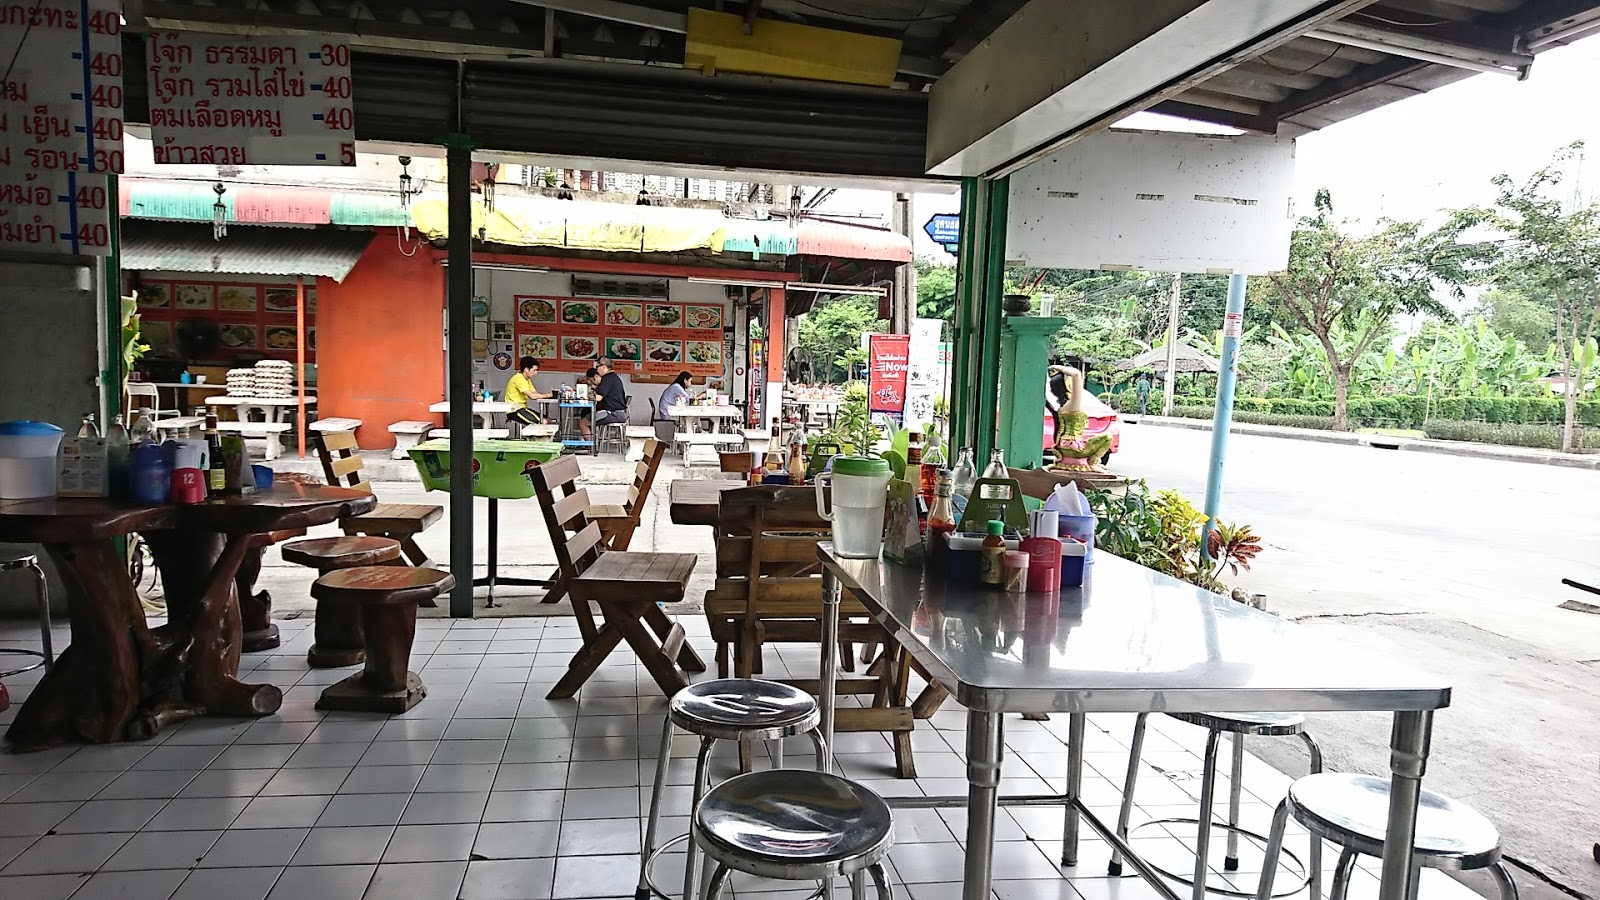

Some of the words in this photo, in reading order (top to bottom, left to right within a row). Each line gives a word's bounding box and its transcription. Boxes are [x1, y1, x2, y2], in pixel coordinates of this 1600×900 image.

[88, 11, 121, 35] 40
[149, 32, 193, 63] โจ๊ก
[205, 45, 297, 64] ธรรมดา
[320, 43, 350, 66] 30
[90, 53, 123, 77] 40
[150, 65, 194, 96] โจ๊ก
[323, 76, 351, 98] 40
[91, 85, 123, 109] 40
[23, 105, 70, 137] เย็น
[92, 117, 124, 141] 40
[150, 97, 282, 137] ต้มเลือดหมู
[324, 107, 353, 130] 40
[93, 149, 125, 174] 30
[153, 137, 246, 164] ข้าวสวย
[339, 143, 356, 166] 5
[75, 186, 106, 209] 40
[0, 209, 56, 243] ้มยำ
[77, 223, 108, 246] 40
[885, 361, 908, 372] Now
[183, 473, 195, 484] 12
